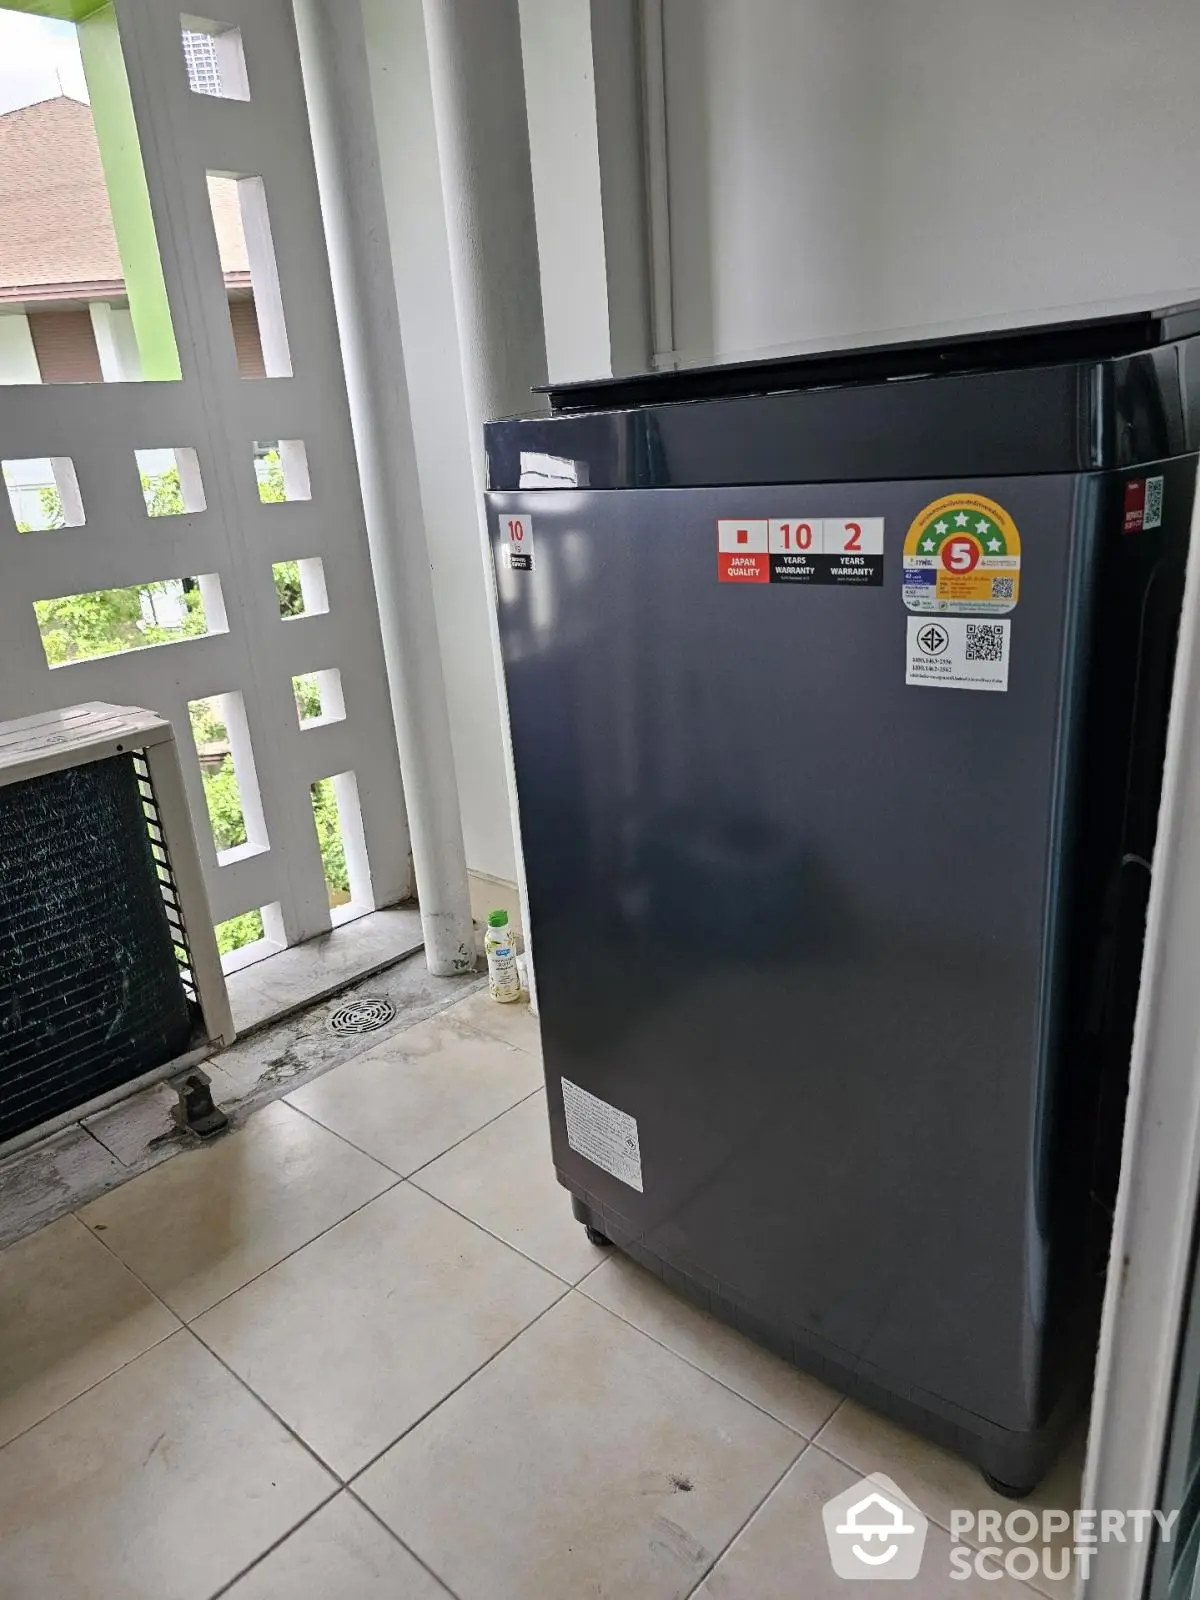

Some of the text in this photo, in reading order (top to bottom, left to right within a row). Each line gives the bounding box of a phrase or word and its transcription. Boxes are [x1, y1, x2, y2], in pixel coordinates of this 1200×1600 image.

[508, 521, 523, 541] 10
[780, 523, 812, 550] 10
[843, 523, 862, 551] 2
[783, 556, 807, 565] YEARS
[951, 543, 971, 570] 5
[731, 558, 756, 567] JAPAN
[840, 557, 865, 566] YEARS
[727, 568, 761, 577] QUALITY
[775, 566, 815, 575] WARRANTY
[830, 567, 874, 576] WARRANTY
